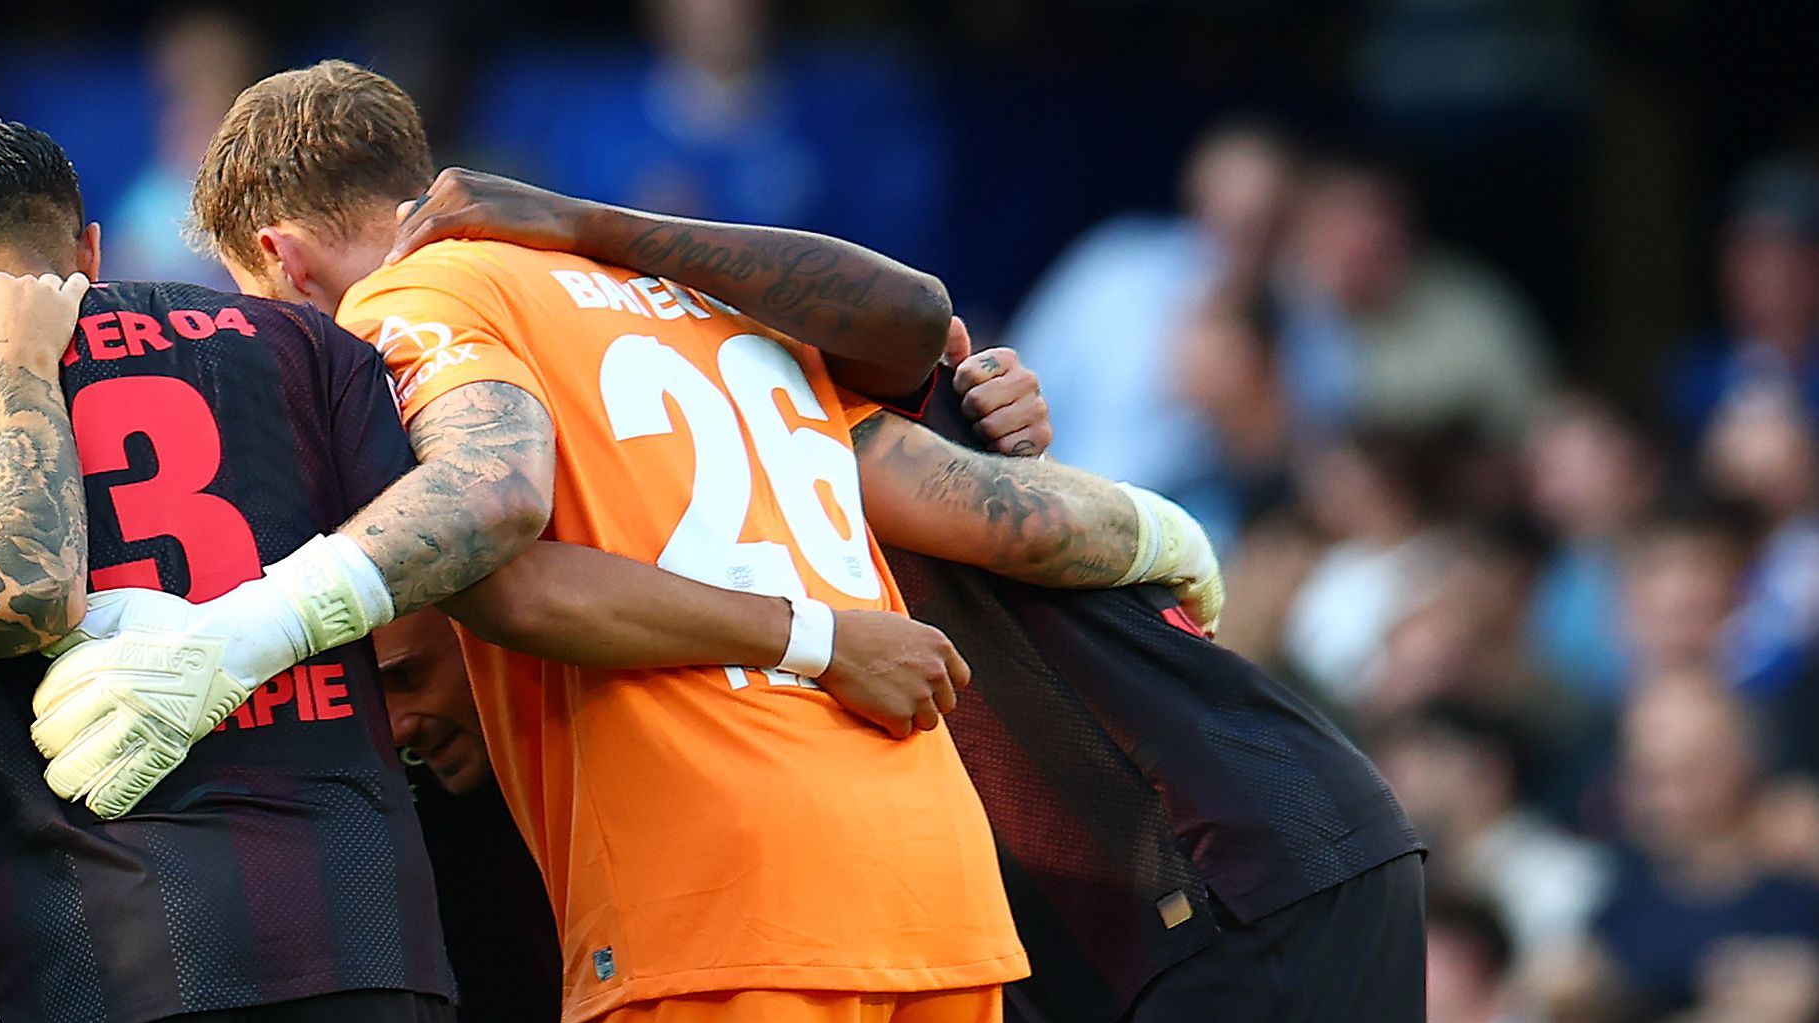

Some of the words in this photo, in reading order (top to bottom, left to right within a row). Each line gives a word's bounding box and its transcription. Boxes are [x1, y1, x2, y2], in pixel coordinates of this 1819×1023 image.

[400, 343, 480, 403] EDAX
[73, 376, 263, 604] 3
[600, 334, 881, 600] 26
[214, 663, 355, 732] APIE
